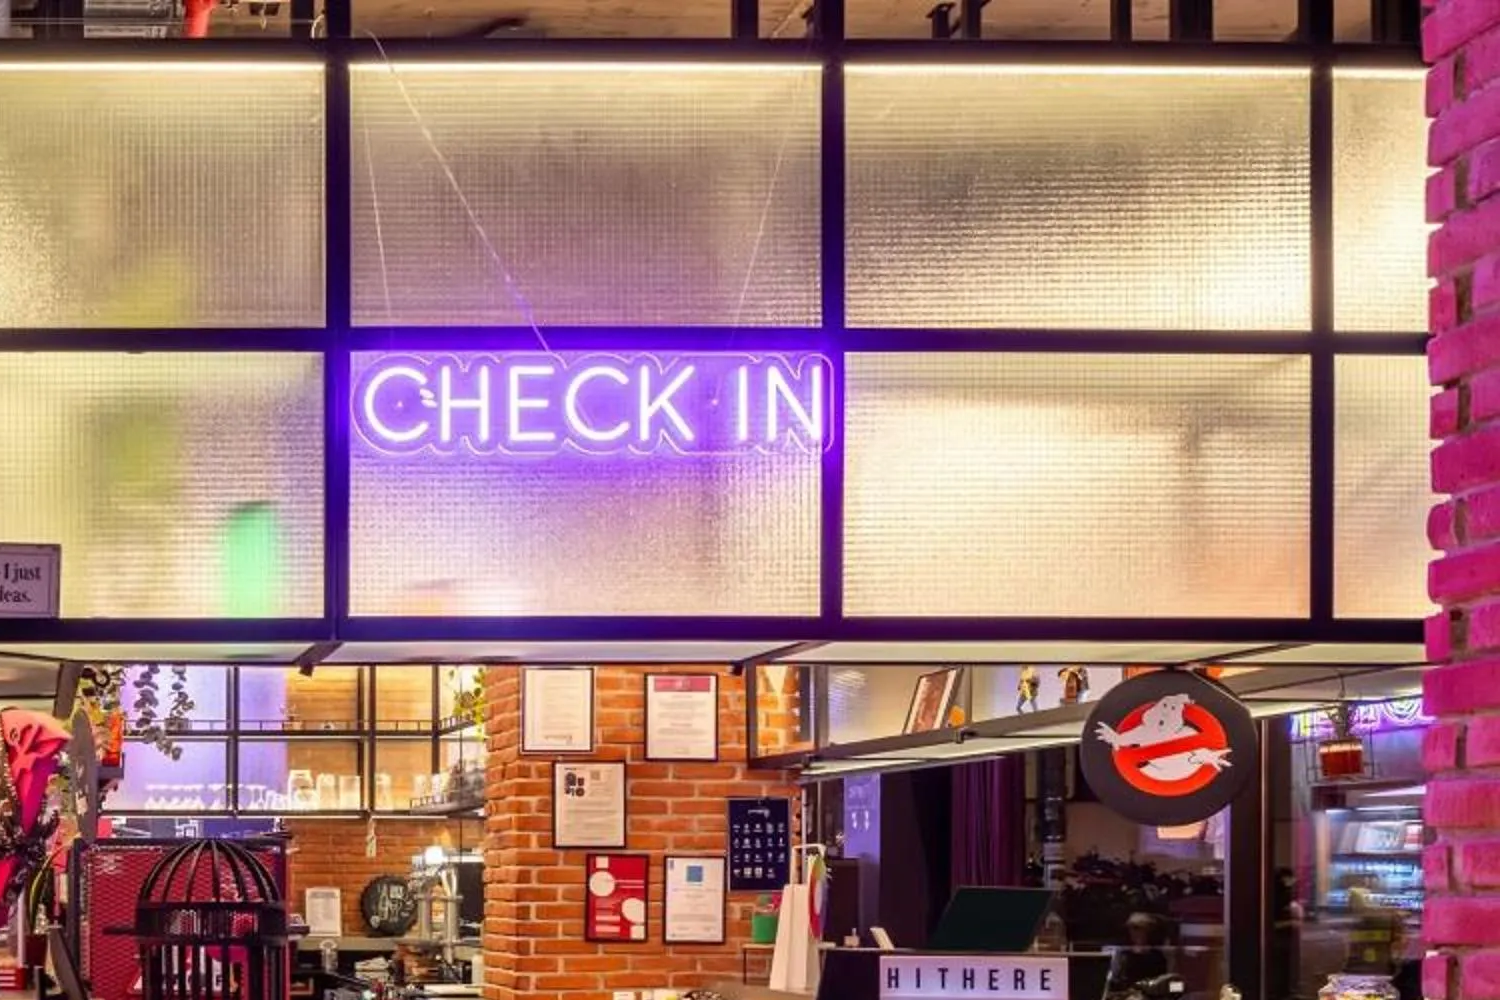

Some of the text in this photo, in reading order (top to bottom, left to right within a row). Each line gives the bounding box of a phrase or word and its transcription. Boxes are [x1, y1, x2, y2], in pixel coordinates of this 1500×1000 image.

[364, 365, 822, 441] CHECK IN
[3, 563, 10, 579] I
[11, 563, 41, 584] just
